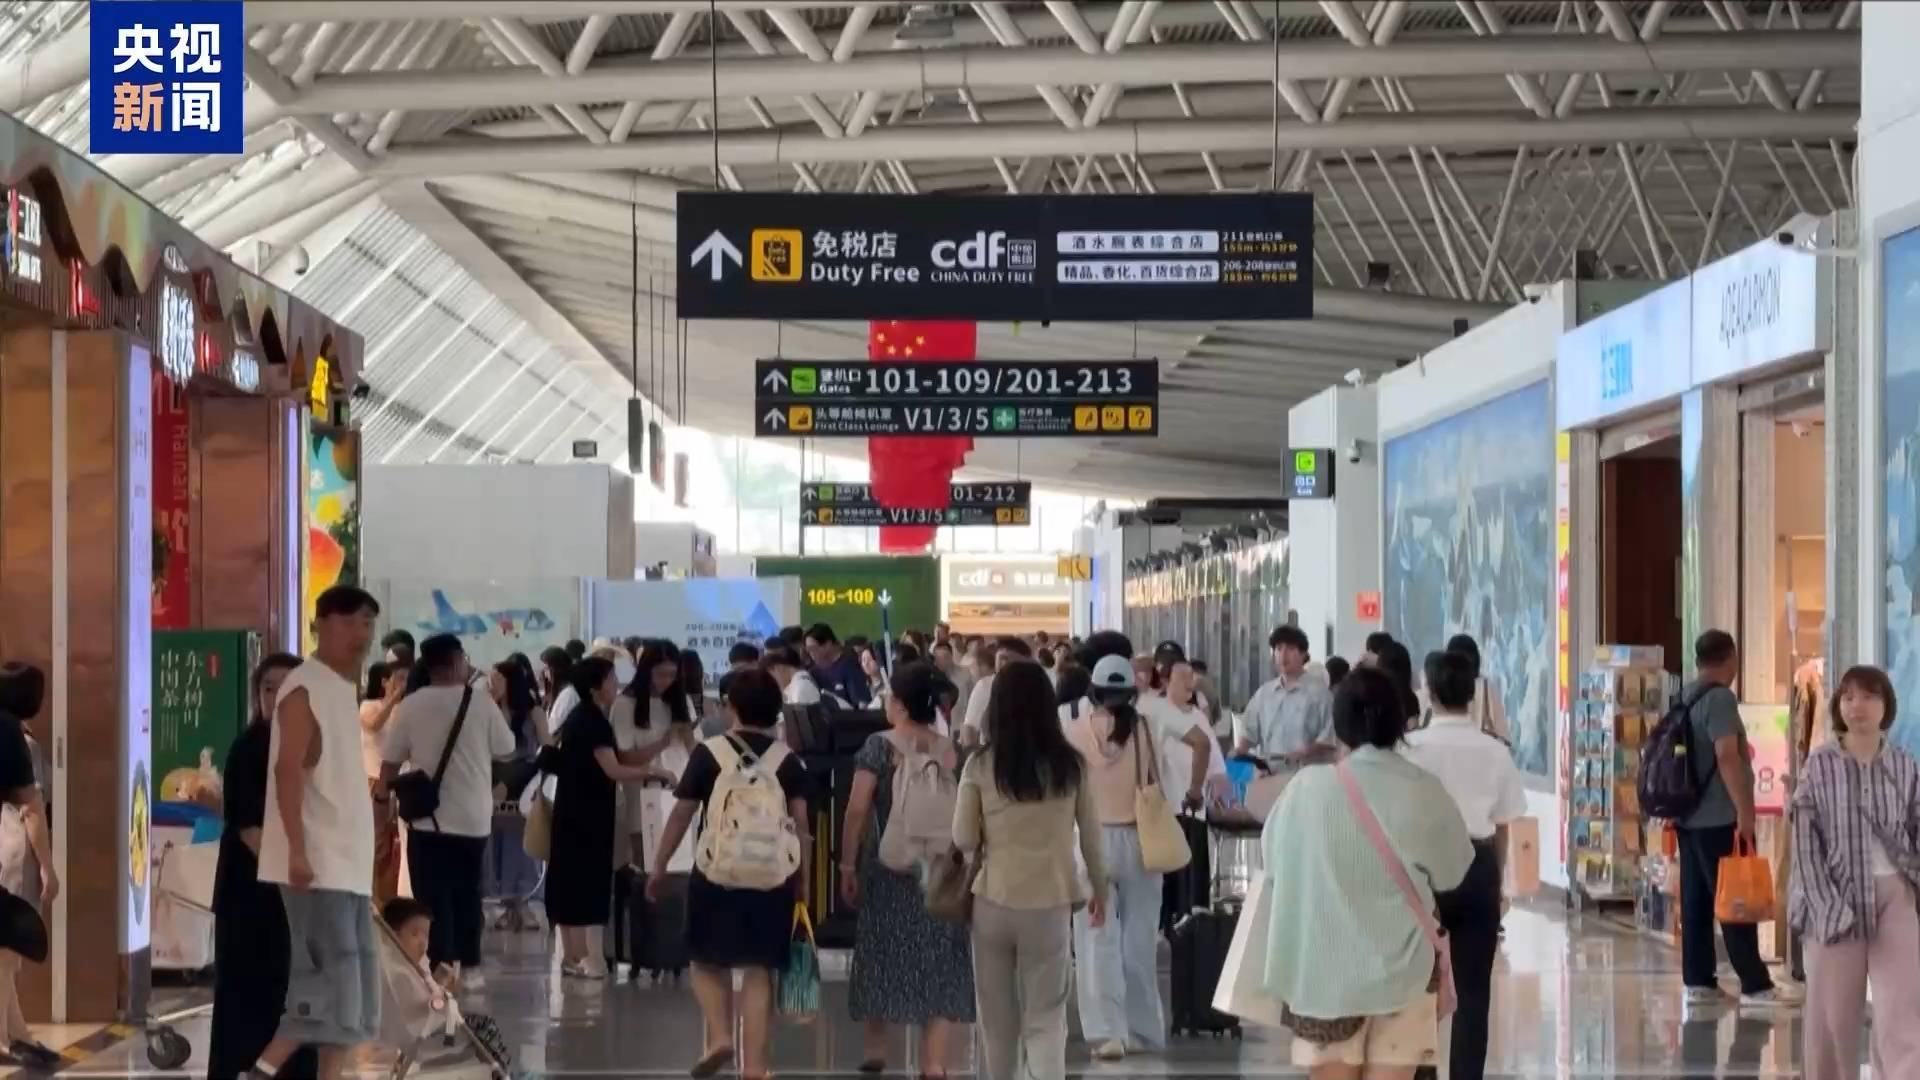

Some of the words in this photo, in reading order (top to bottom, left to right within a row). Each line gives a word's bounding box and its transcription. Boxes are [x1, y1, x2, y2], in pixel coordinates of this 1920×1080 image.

[812, 231, 897, 258] 免税店
[931, 231, 1006, 269] cdf
[811, 262, 863, 286] Duty
[871, 263, 920, 283] Free
[931, 272, 969, 283] CHINA
[973, 272, 1004, 283] DUTY
[1008, 272, 1034, 283] FREE
[819, 384, 850, 394] Gates
[866, 368, 1132, 393] 101-109/201-213
[904, 407, 988, 431] V1/3/5
[173, 423, 188, 501] Hainan
[891, 507, 943, 523] V1/3/5
